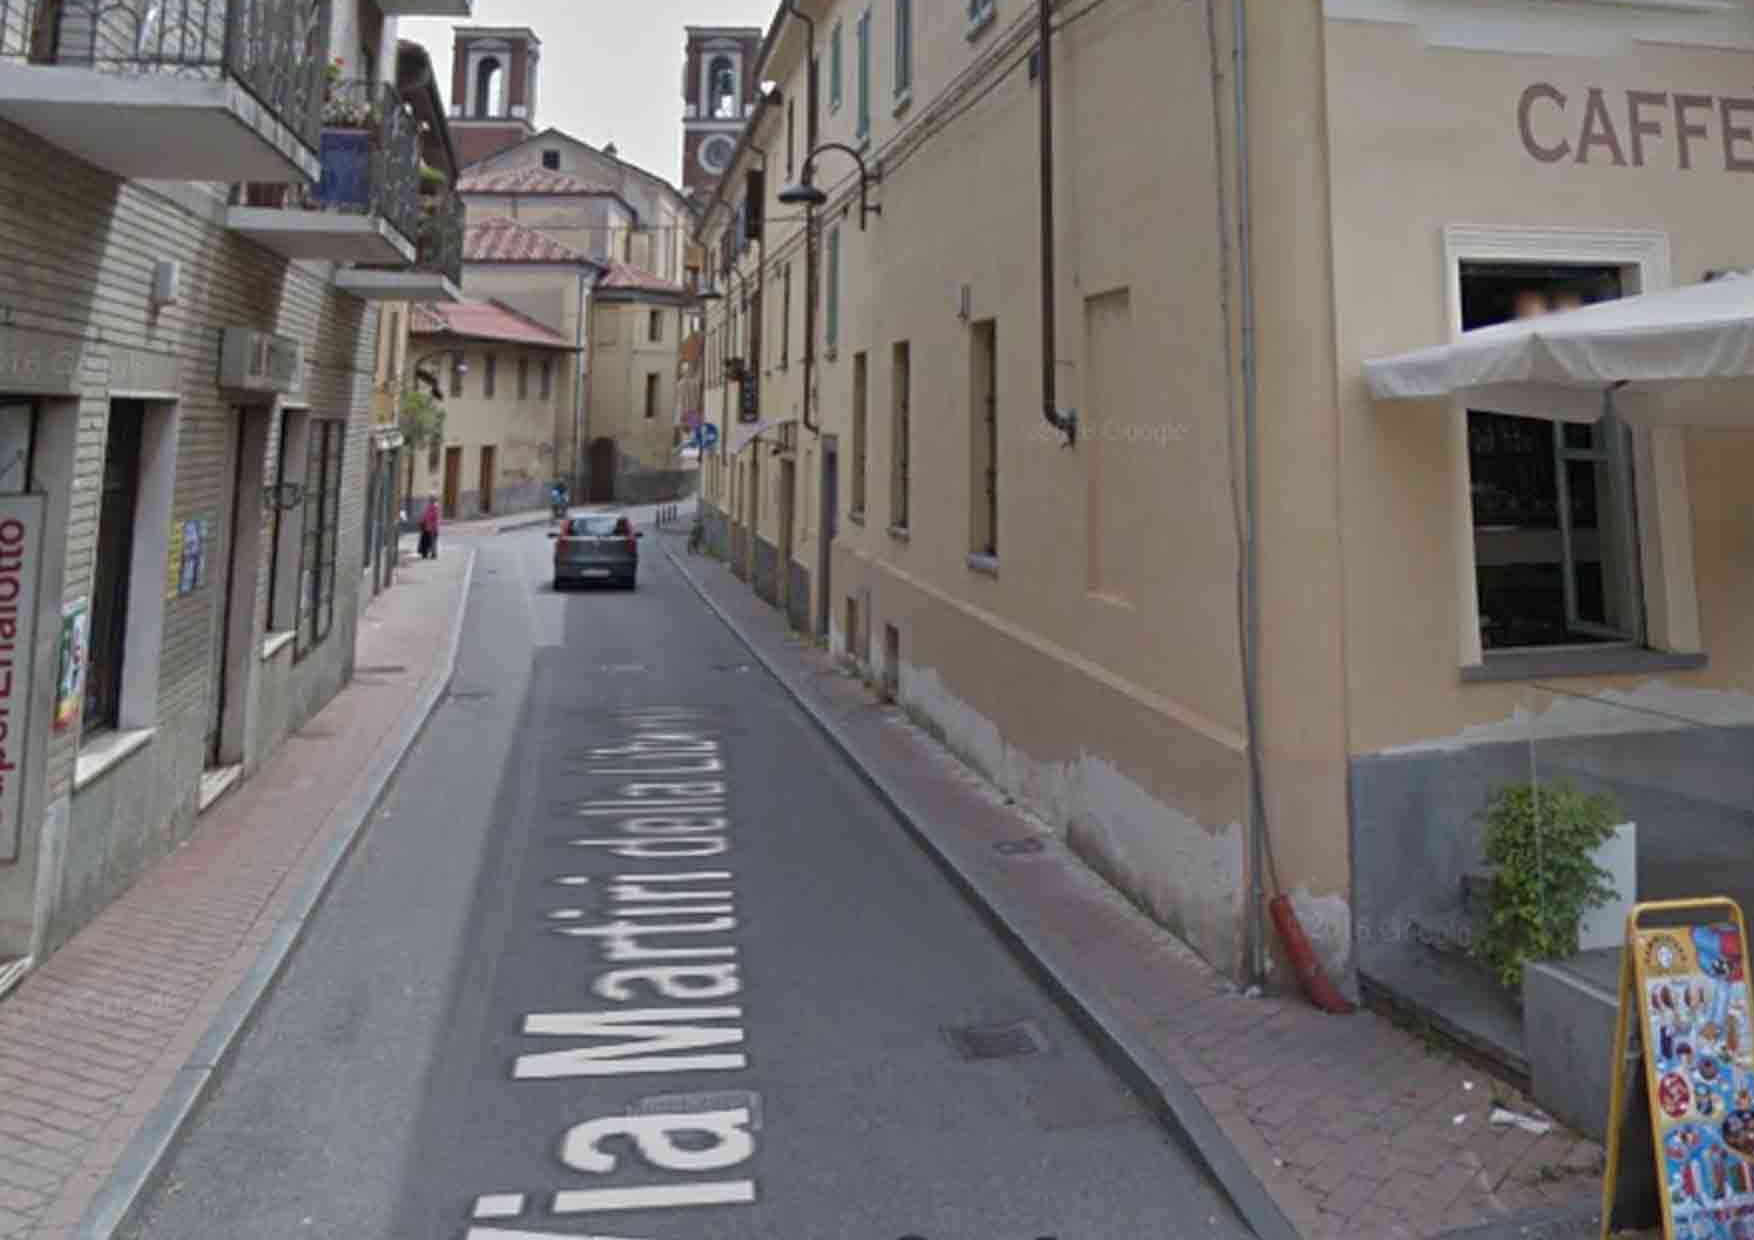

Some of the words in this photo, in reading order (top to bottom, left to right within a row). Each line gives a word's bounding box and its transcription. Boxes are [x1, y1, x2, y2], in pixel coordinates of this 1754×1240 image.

[568, 781, 728, 857] della
[511, 871, 746, 1079] Martiri
[466, 1107, 756, 1240] ia
